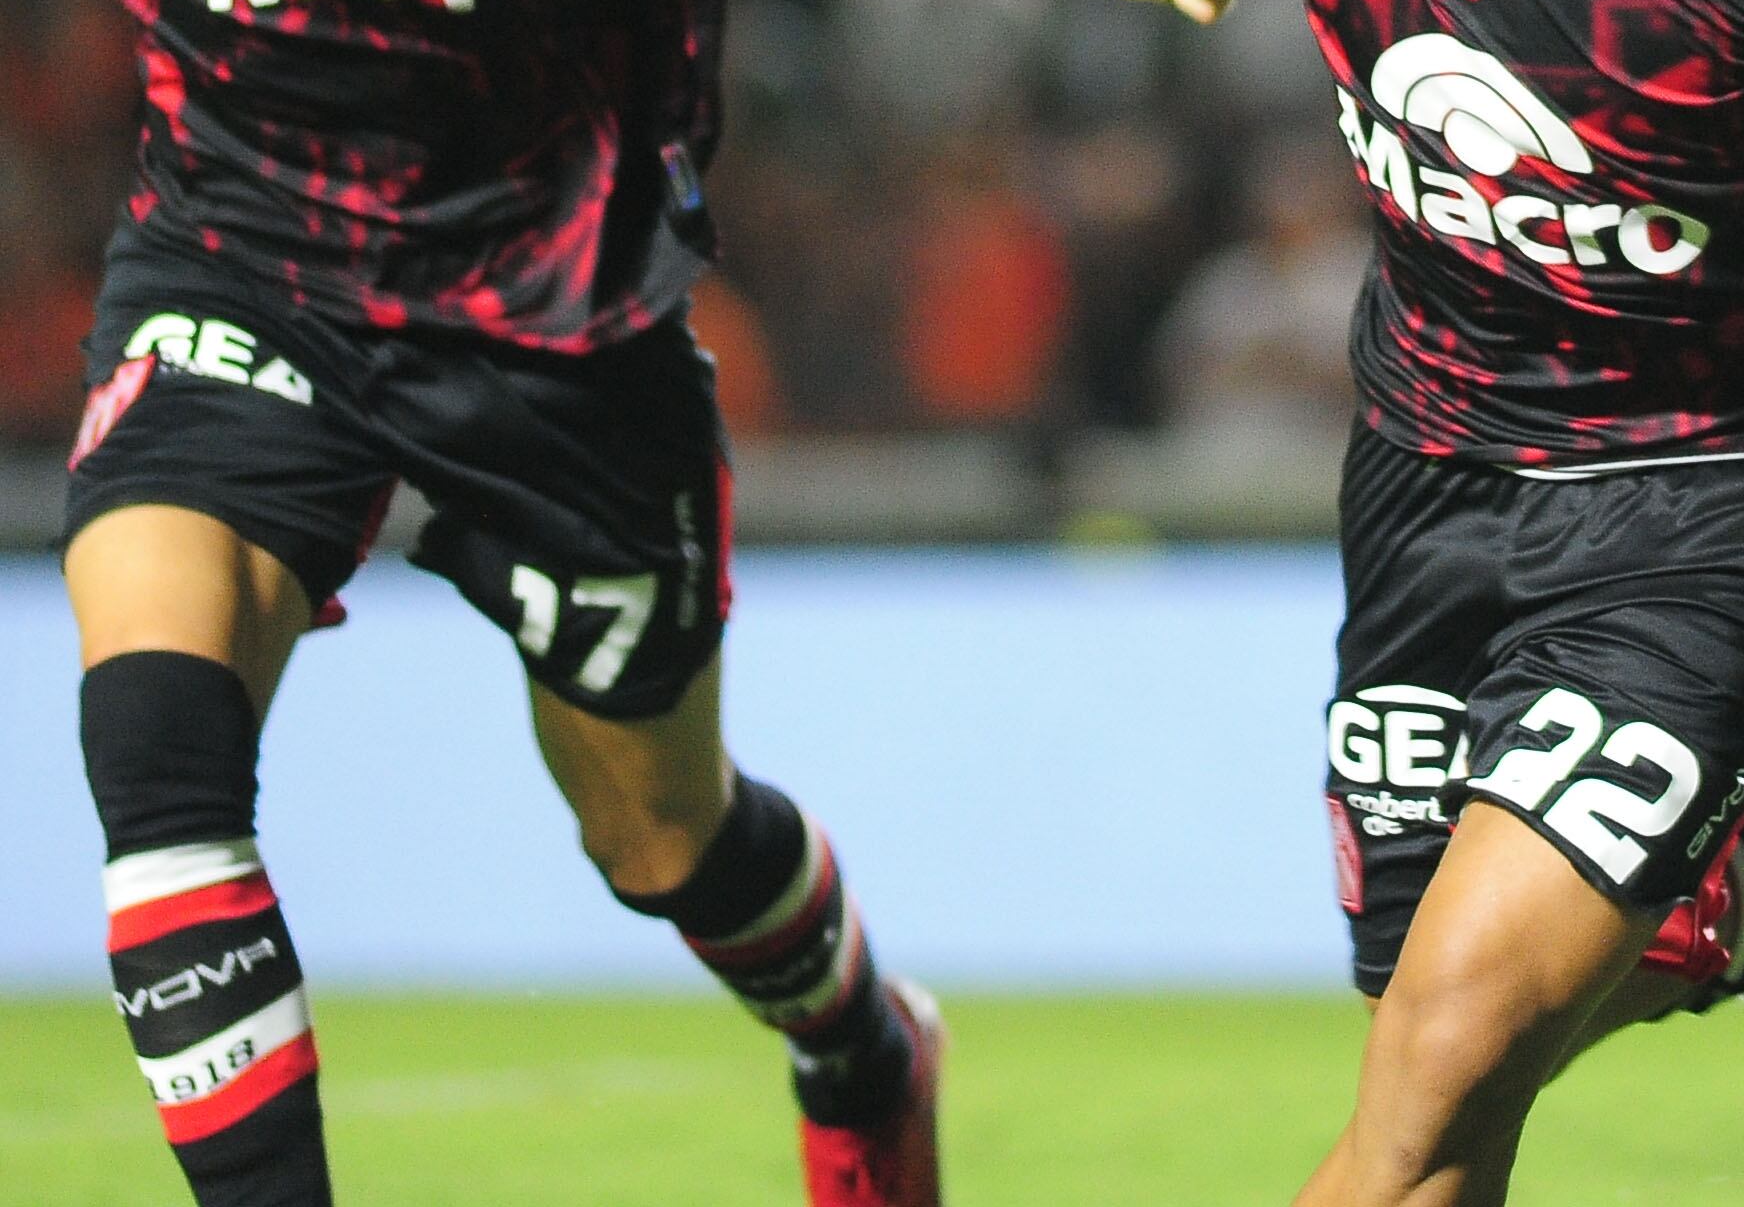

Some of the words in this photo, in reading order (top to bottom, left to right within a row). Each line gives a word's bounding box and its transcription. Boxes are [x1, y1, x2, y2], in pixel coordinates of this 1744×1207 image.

[1335, 84, 1711, 275] Macro
[509, 563, 659, 694] 17
[1465, 686, 1701, 886] 22
[144, 1038, 256, 1103] 1918
